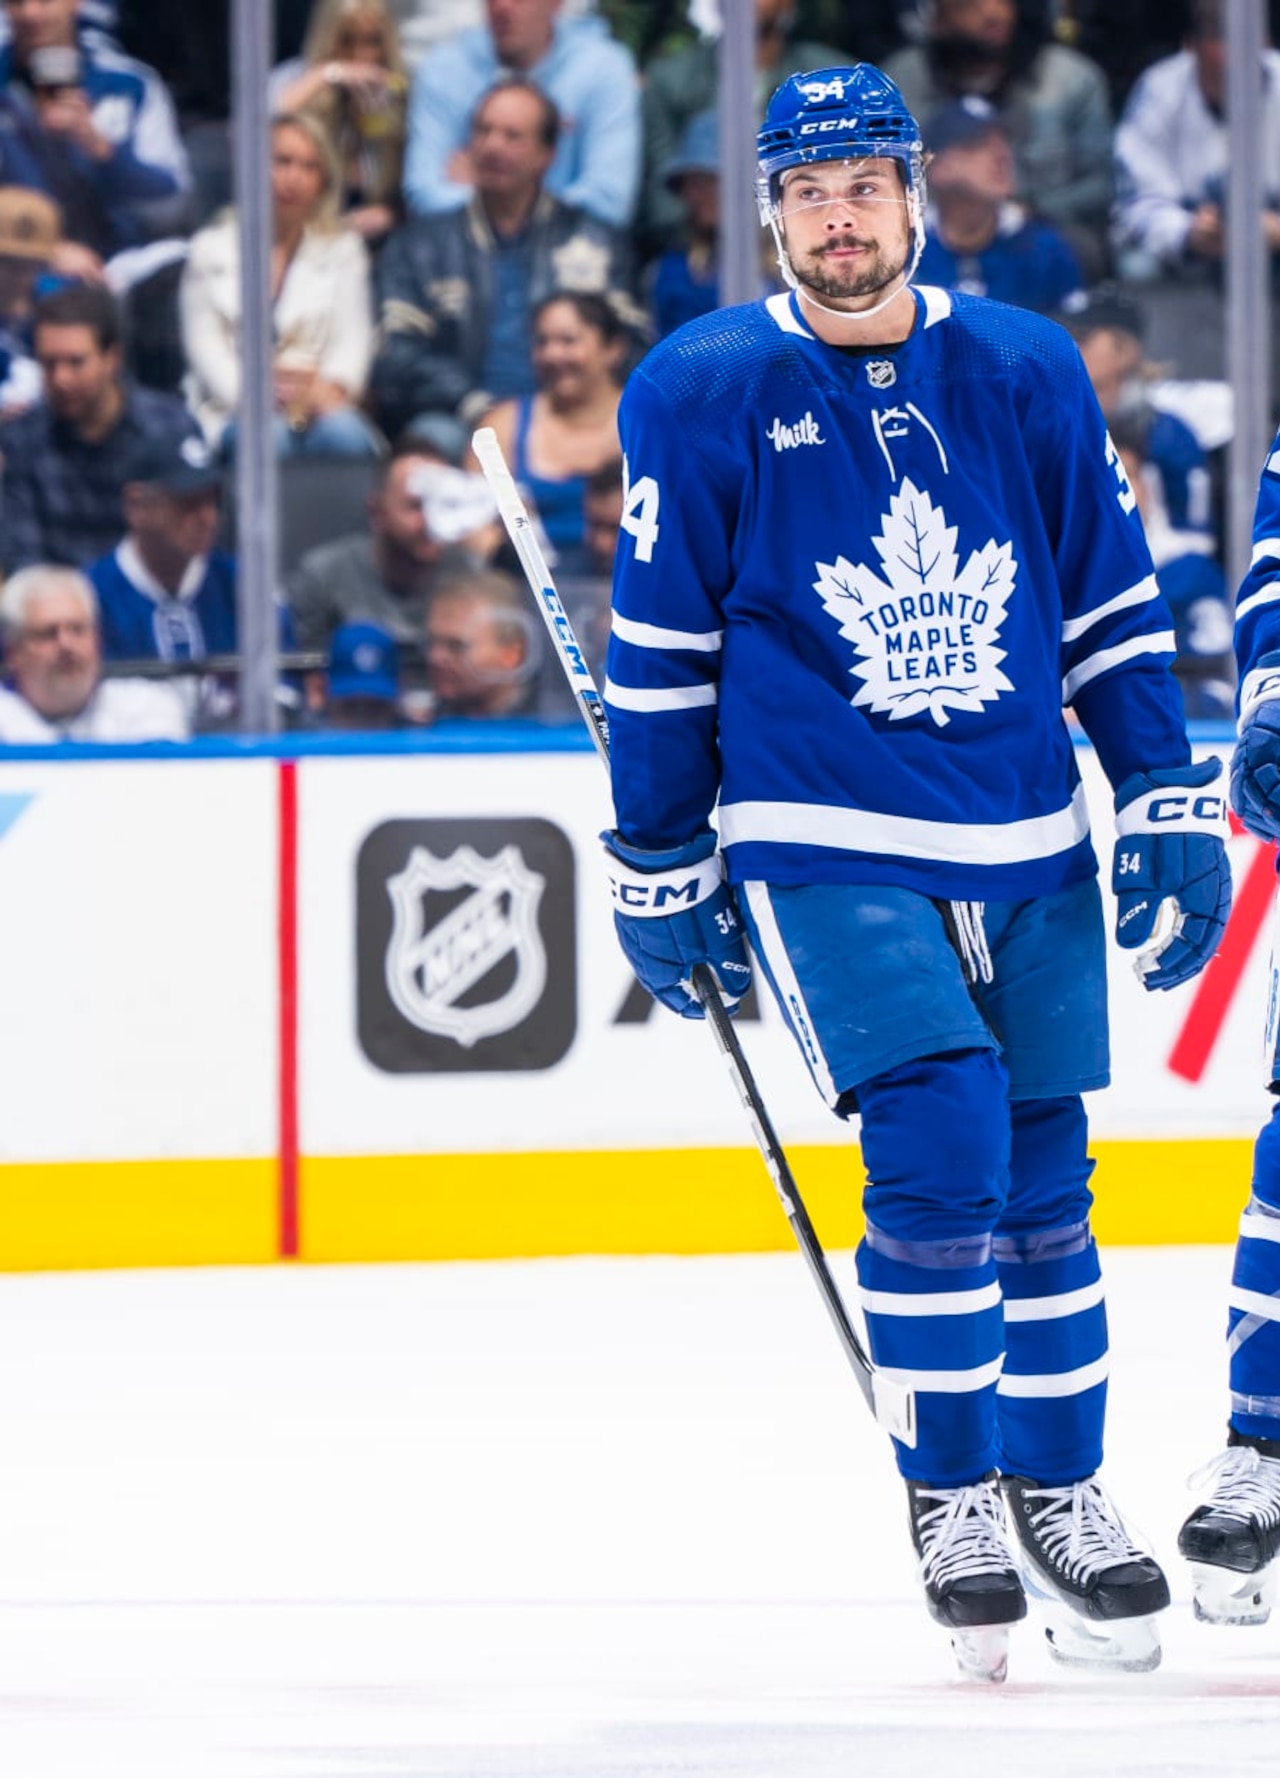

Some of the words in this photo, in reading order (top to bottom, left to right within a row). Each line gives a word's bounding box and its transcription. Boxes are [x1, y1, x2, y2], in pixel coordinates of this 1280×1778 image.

[799, 118, 859, 135] CCM
[765, 410, 827, 453] Milk
[858, 591, 989, 637] TORONTO
[541, 586, 590, 677] CCM
[885, 624, 975, 655] MAPLE
[886, 651, 978, 682] LEAFS
[1146, 797, 1227, 822] CC
[1118, 852, 1141, 875] 34
[714, 907, 738, 935] 34
[1119, 901, 1149, 928] CCM
[789, 993, 818, 1065] CCM
